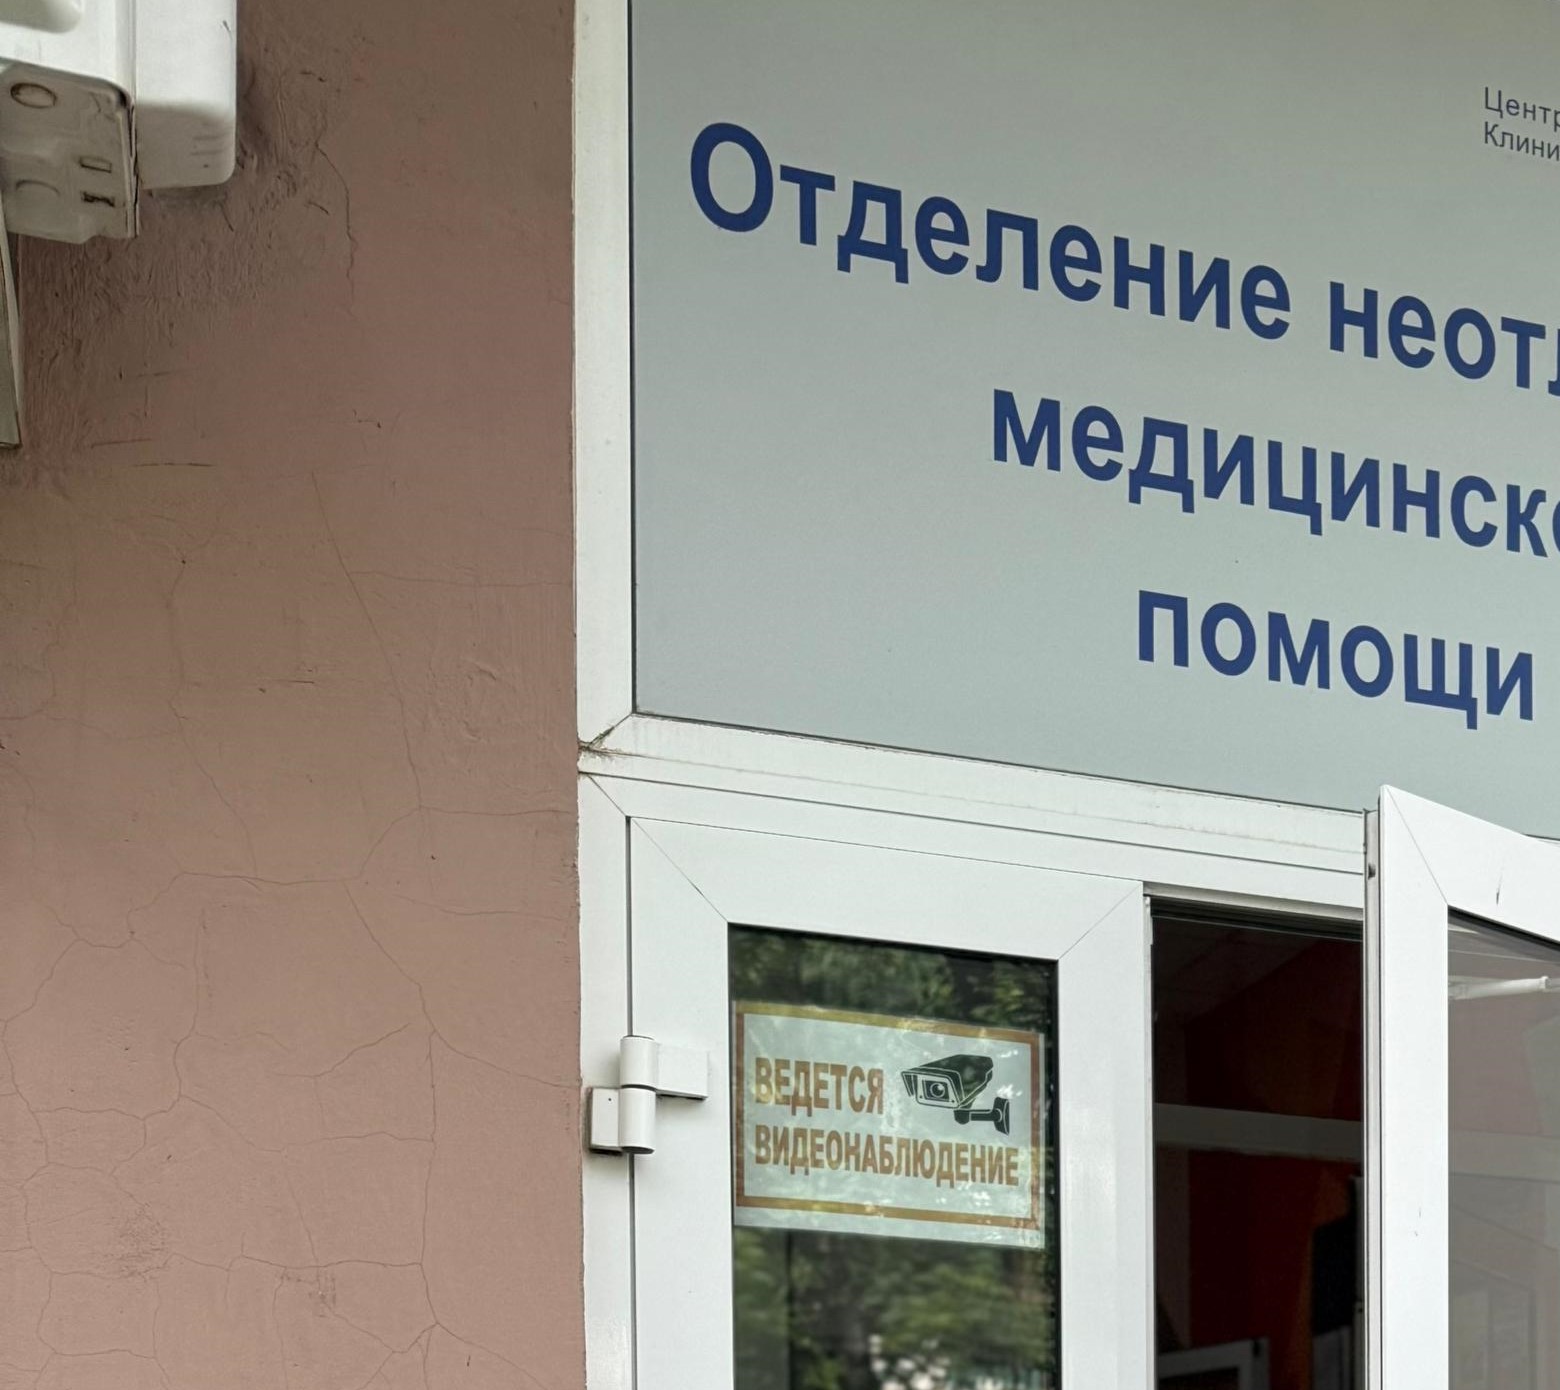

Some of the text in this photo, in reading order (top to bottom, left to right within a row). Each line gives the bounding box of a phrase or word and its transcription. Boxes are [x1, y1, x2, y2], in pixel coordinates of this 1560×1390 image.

[690, 122, 1292, 340] Отделение
[1138, 589, 1533, 731] помощи
[755, 1056, 884, 1117] ВЕДЕТСЯ
[755, 1124, 1019, 1189] ВИДЕОНАБЛЮДЕНИЕ
